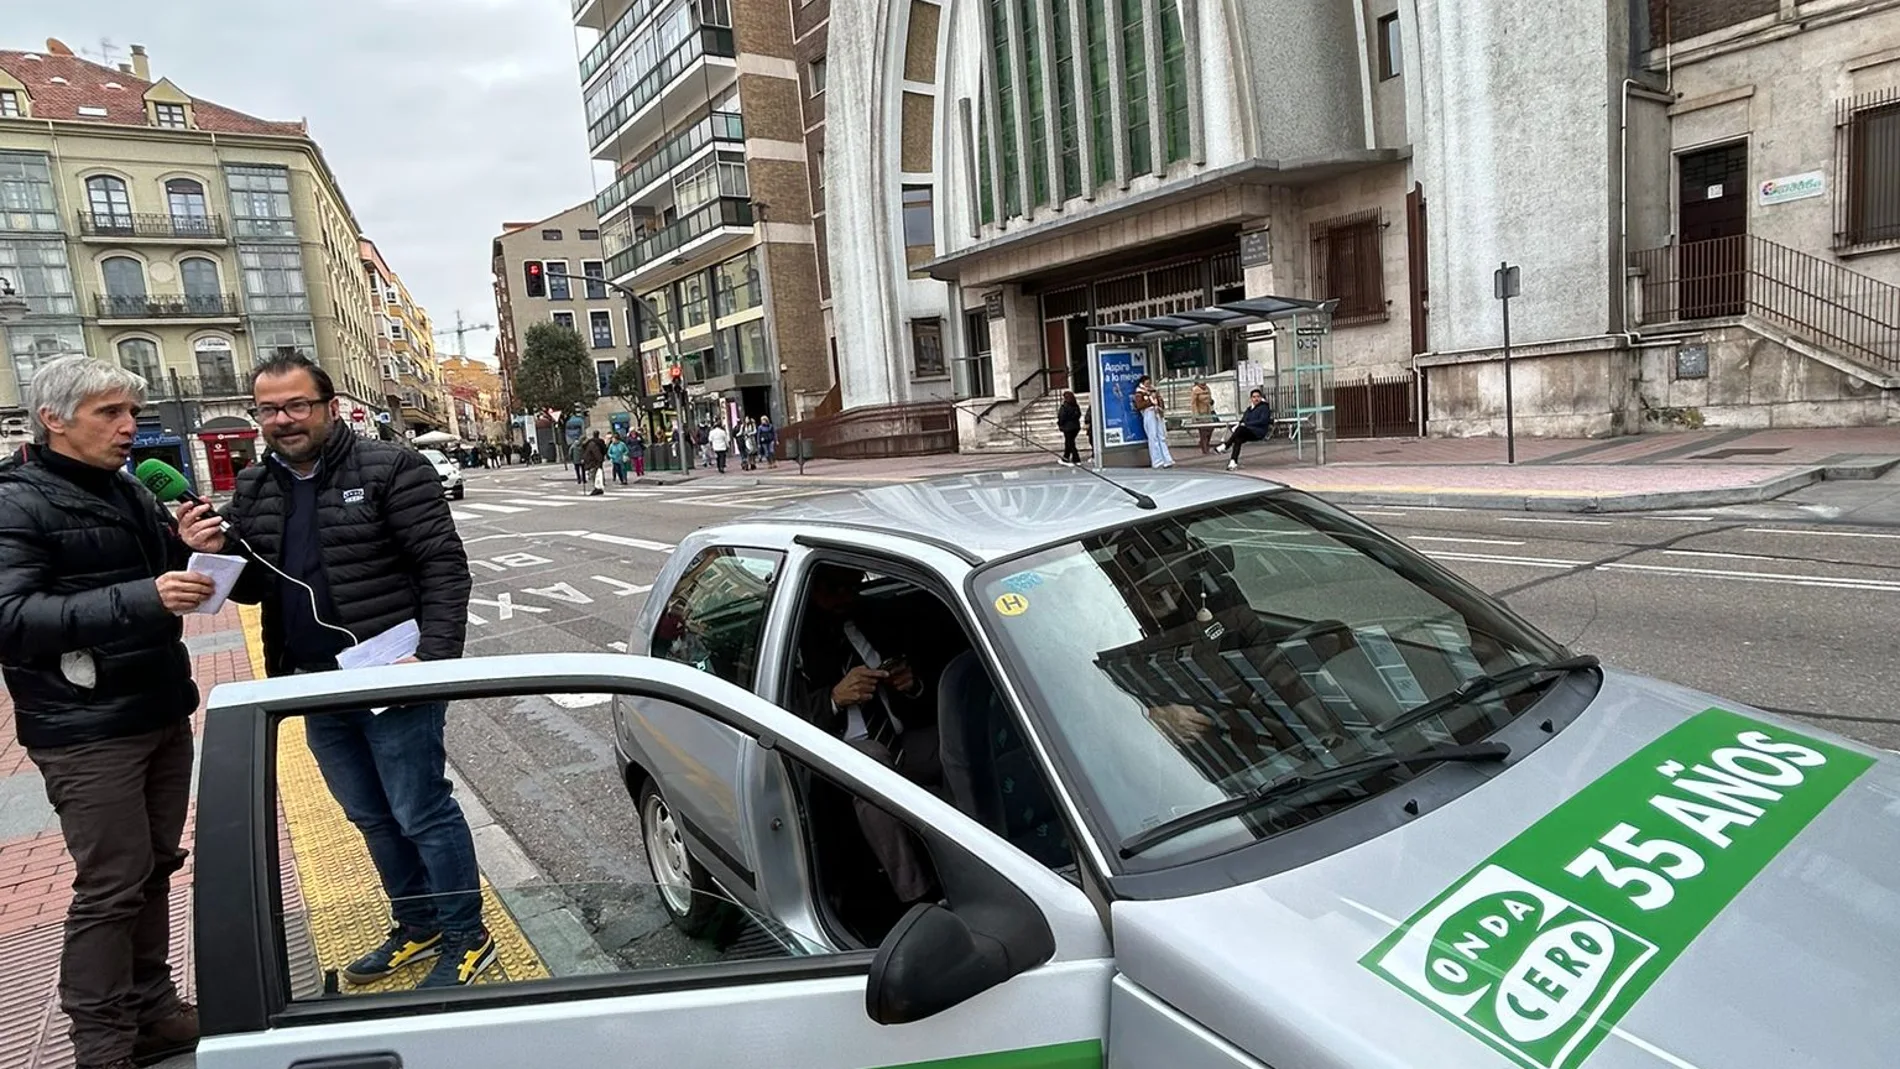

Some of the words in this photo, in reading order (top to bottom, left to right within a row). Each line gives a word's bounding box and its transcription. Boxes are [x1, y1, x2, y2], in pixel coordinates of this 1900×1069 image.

[1111, 374, 1119, 382] lo
[1120, 372, 1143, 384] mejor
[1002, 595, 1023, 611] H
[1563, 822, 1707, 912] 35
[1648, 730, 1828, 850] AÑOS
[1431, 890, 1536, 984] ONDA
[1506, 931, 1604, 1022] CERO
